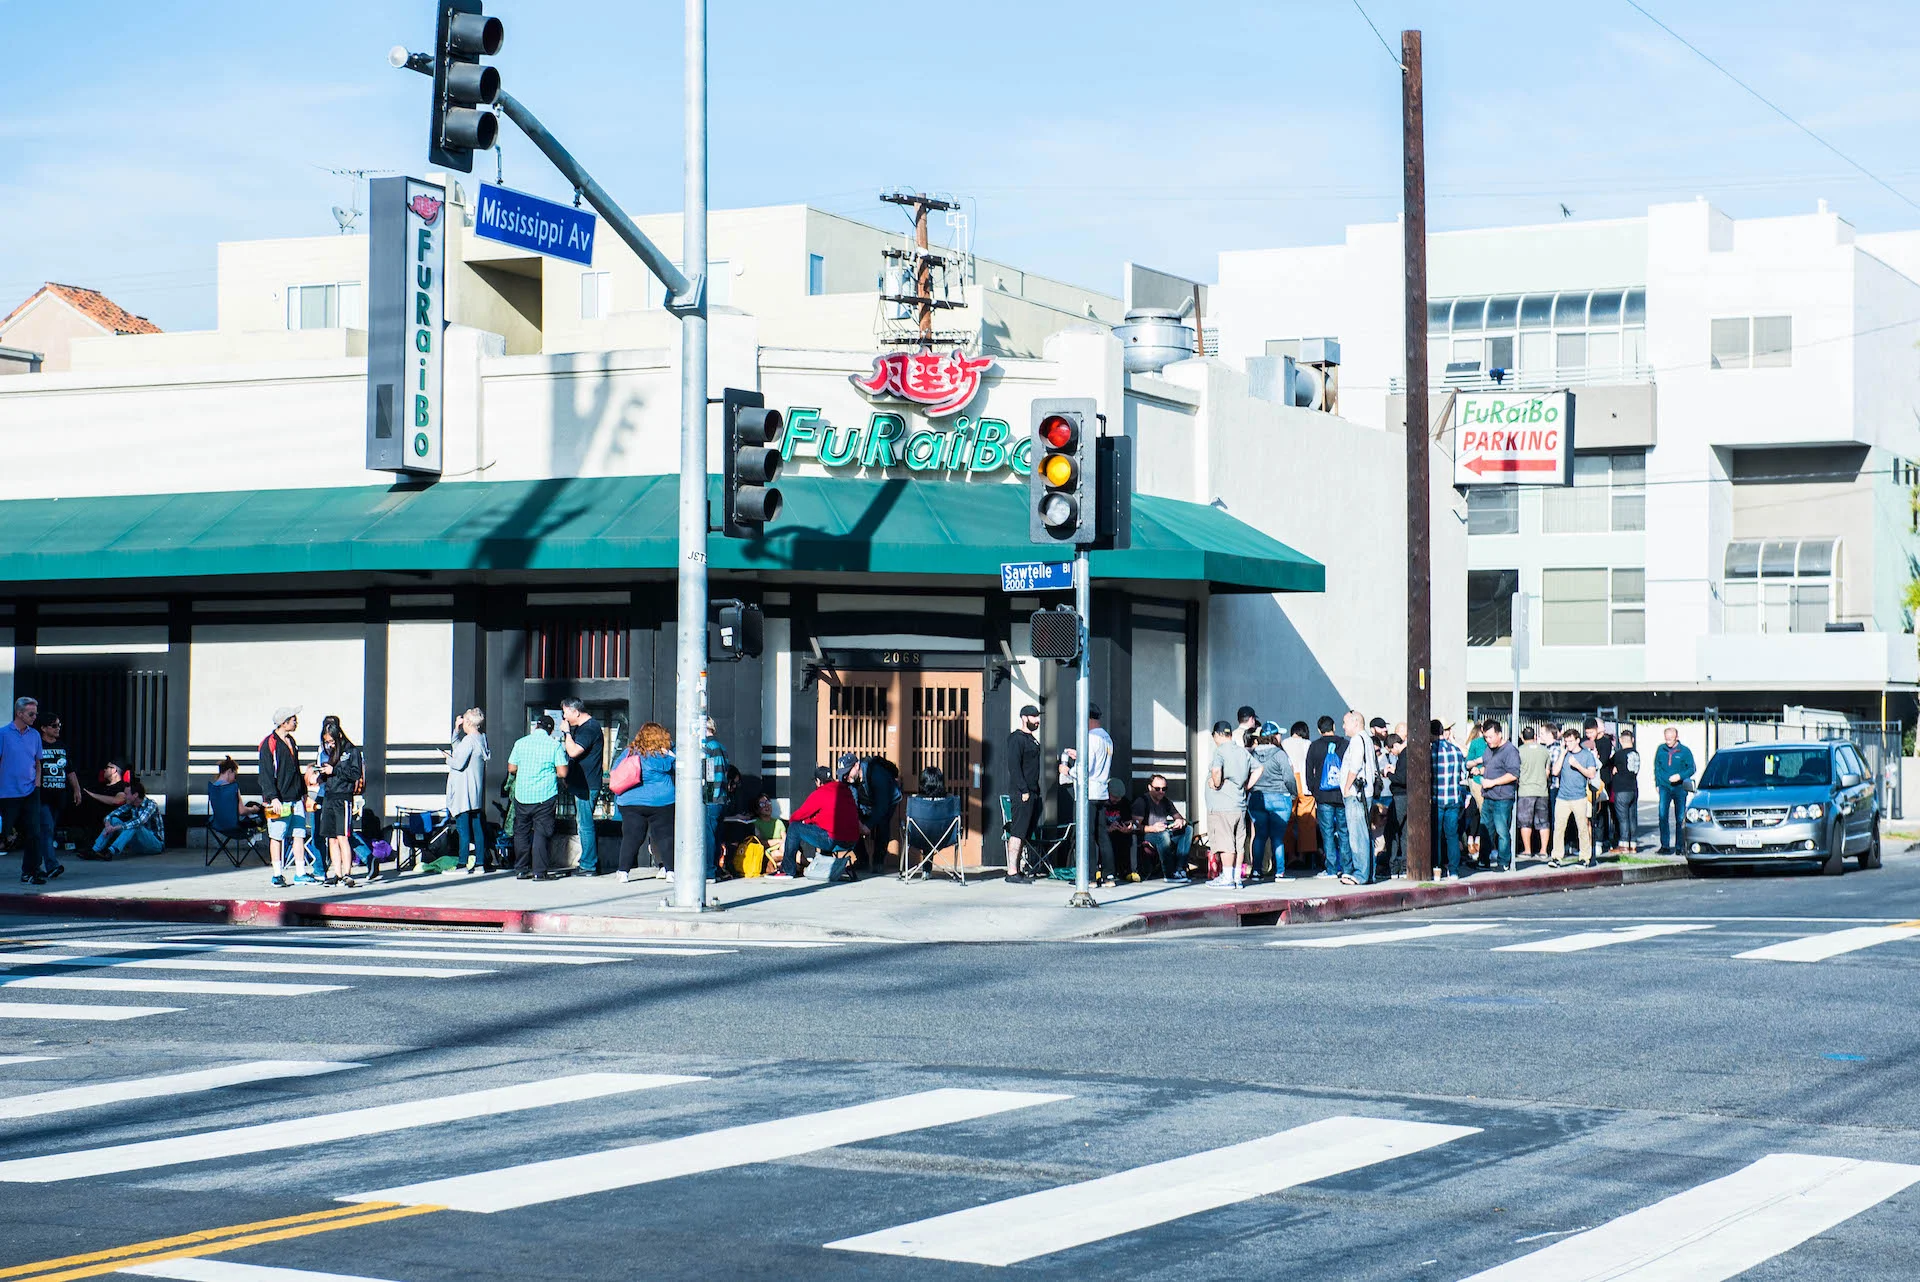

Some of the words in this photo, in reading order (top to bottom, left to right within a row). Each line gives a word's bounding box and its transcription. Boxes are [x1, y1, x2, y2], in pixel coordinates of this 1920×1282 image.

[481, 197, 564, 248] Mississippi
[567, 222, 591, 252] Av
[1463, 399, 1559, 424] FuRaiBo
[1463, 430, 1558, 451] PARKING
[1005, 564, 1053, 580] Sawtelle
[1005, 579, 1026, 590] 2000
[1028, 579, 1035, 589] S
[883, 651, 920, 664] 2068
